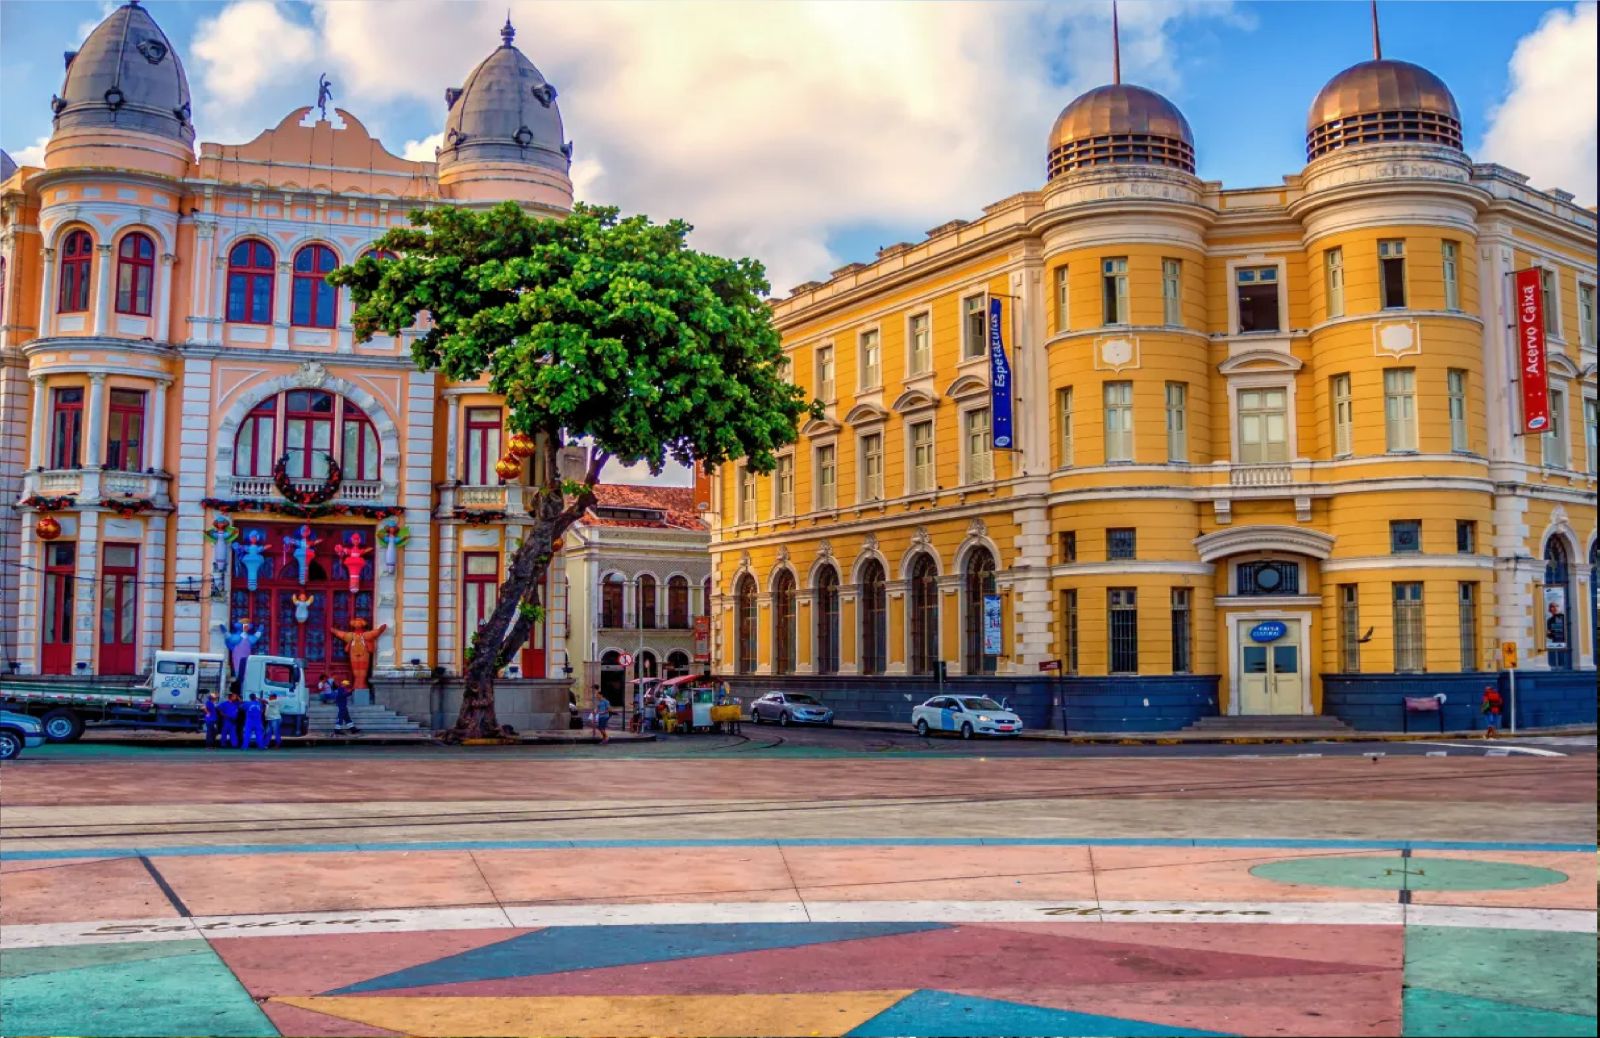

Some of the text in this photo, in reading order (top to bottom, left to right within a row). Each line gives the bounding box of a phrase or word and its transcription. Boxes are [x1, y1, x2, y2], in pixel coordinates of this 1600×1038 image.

[1522, 284, 1539, 374] Acervo Caixa
[79, 918, 404, 936] Saturno
